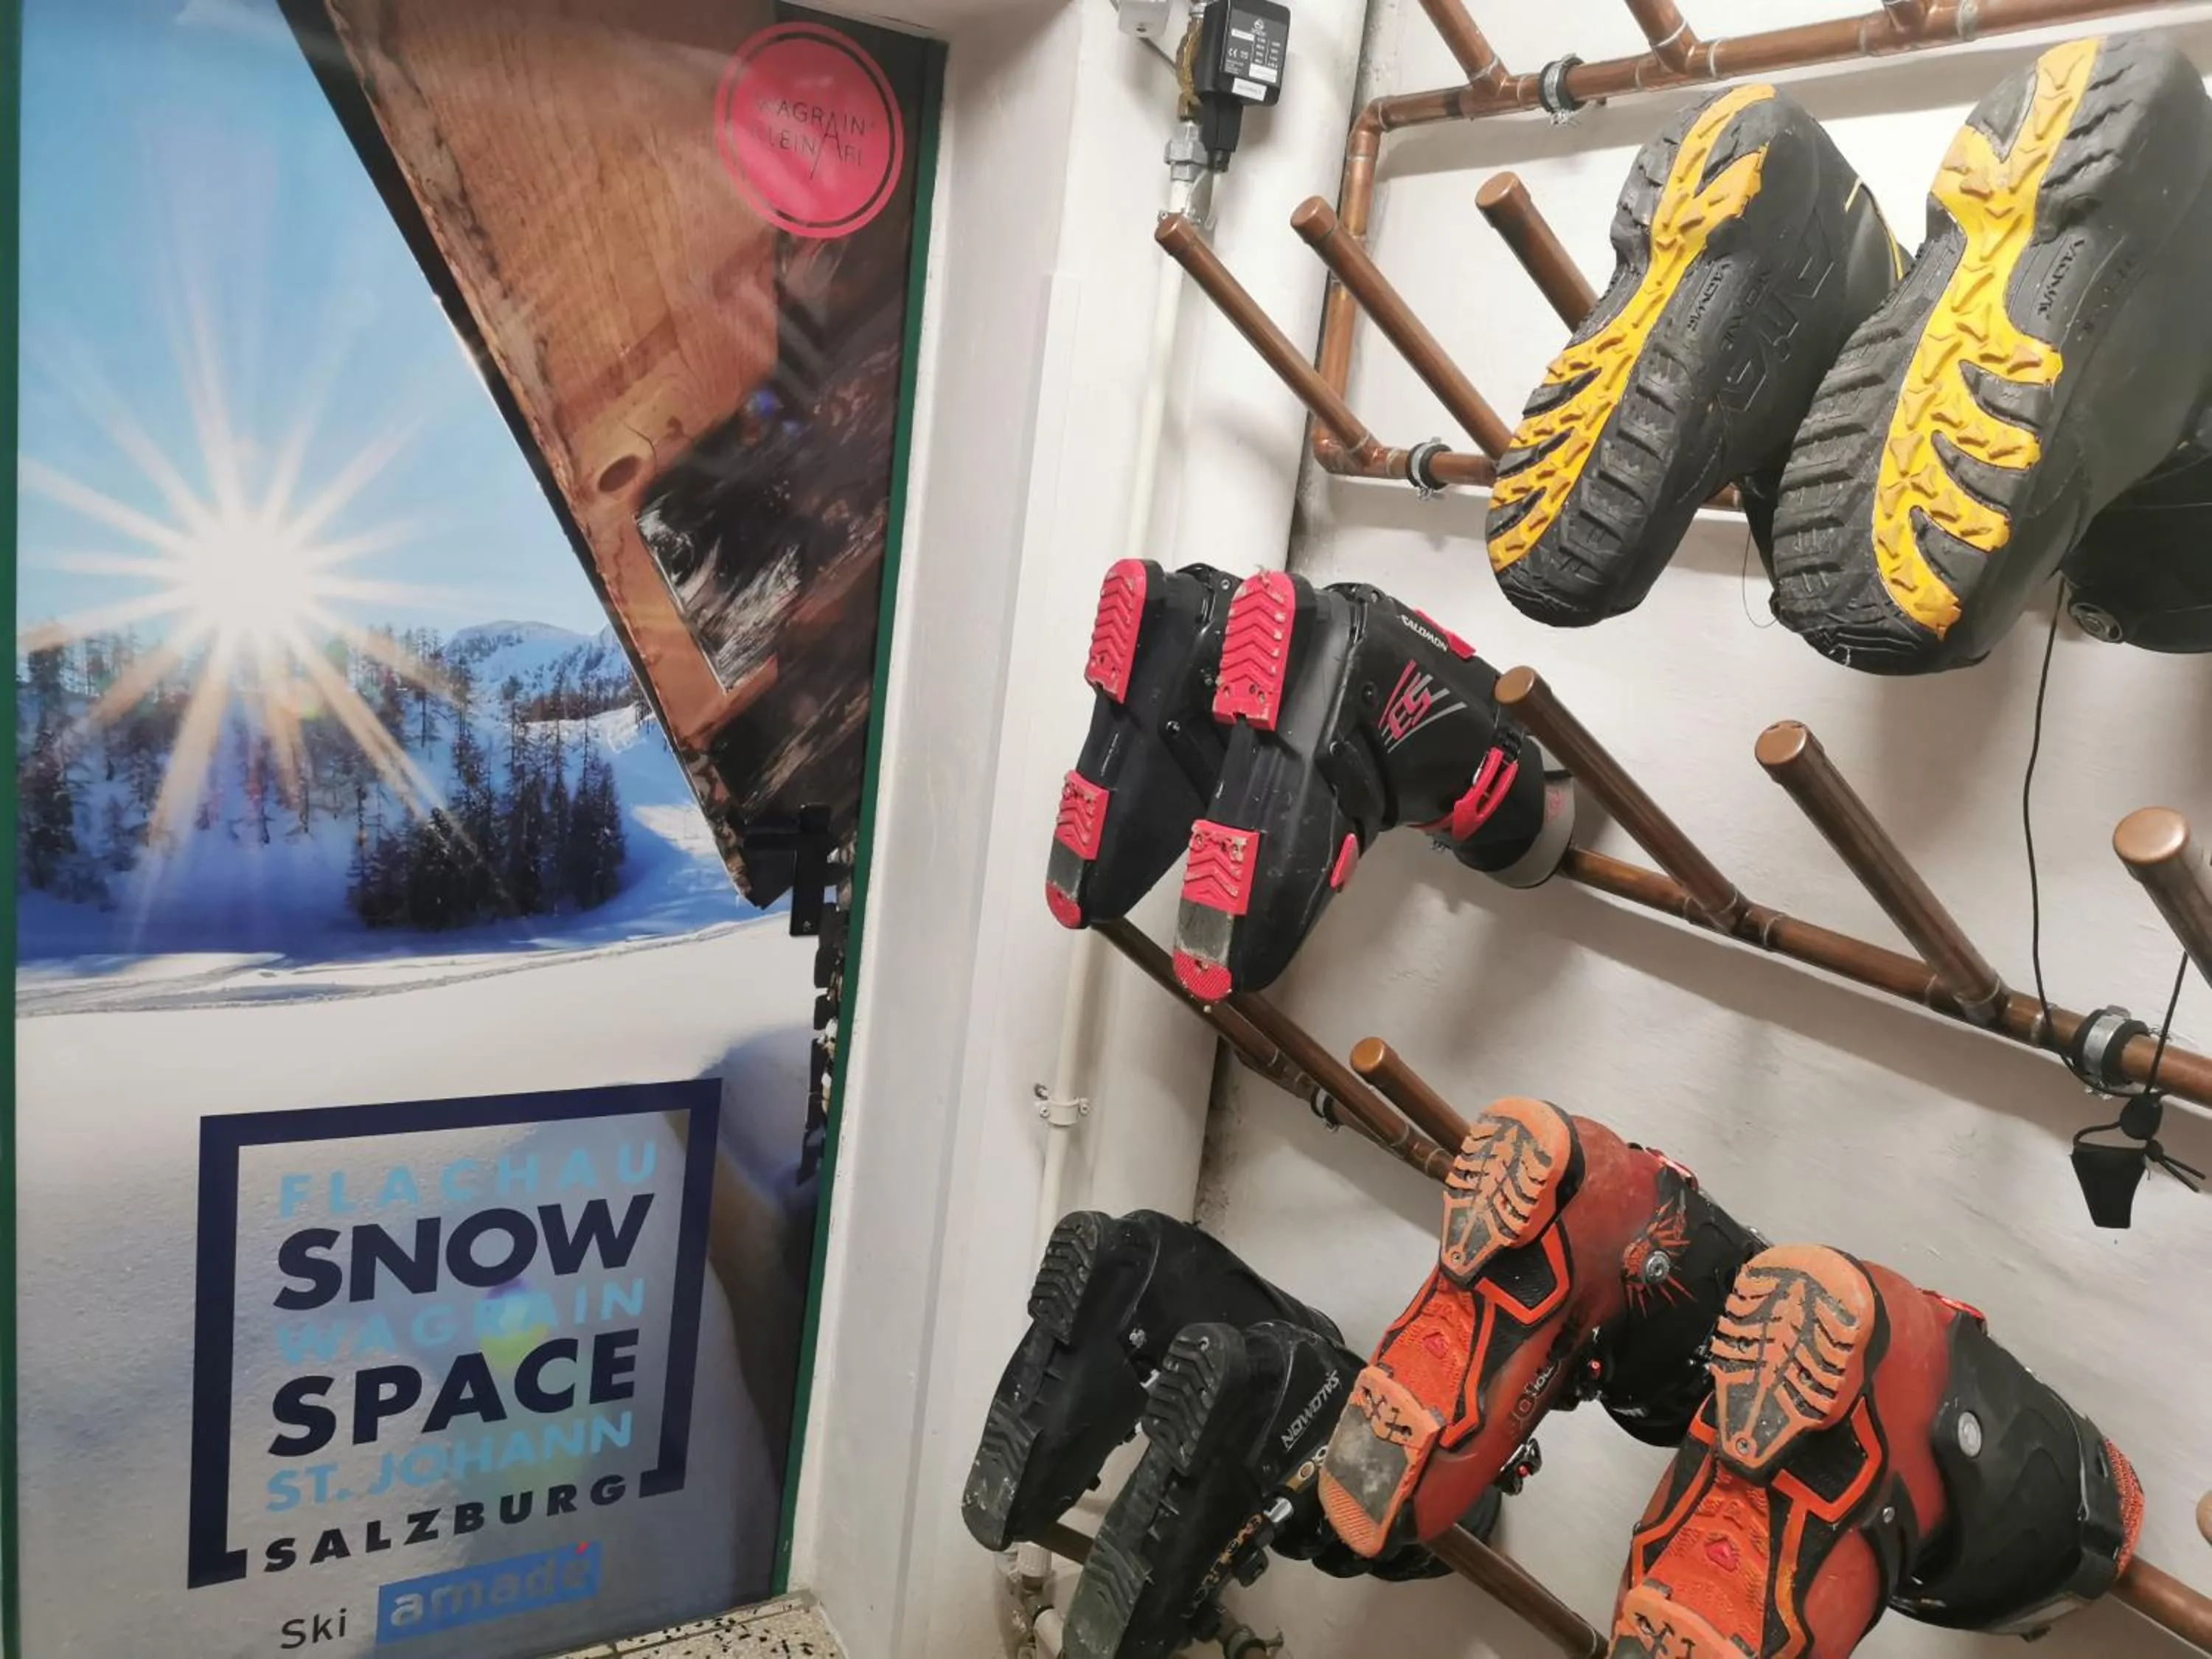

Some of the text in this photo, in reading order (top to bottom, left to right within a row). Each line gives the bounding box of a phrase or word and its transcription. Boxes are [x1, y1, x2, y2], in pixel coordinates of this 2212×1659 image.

[758, 98, 866, 138] AGRAIN
[1400, 614, 1449, 653] SALOMON
[279, 1140, 658, 1220] FLACHAU
[273, 1192, 655, 1310] SNOW
[276, 1277, 645, 1366] WAGRAIN
[268, 1329, 640, 1457] SPACE
[1281, 1369, 1340, 1451] SALOMON
[265, 1411, 633, 1512] ST. JOHANN
[263, 1475, 627, 1573] SALZBURG
[279, 1608, 347, 1650] Ski
